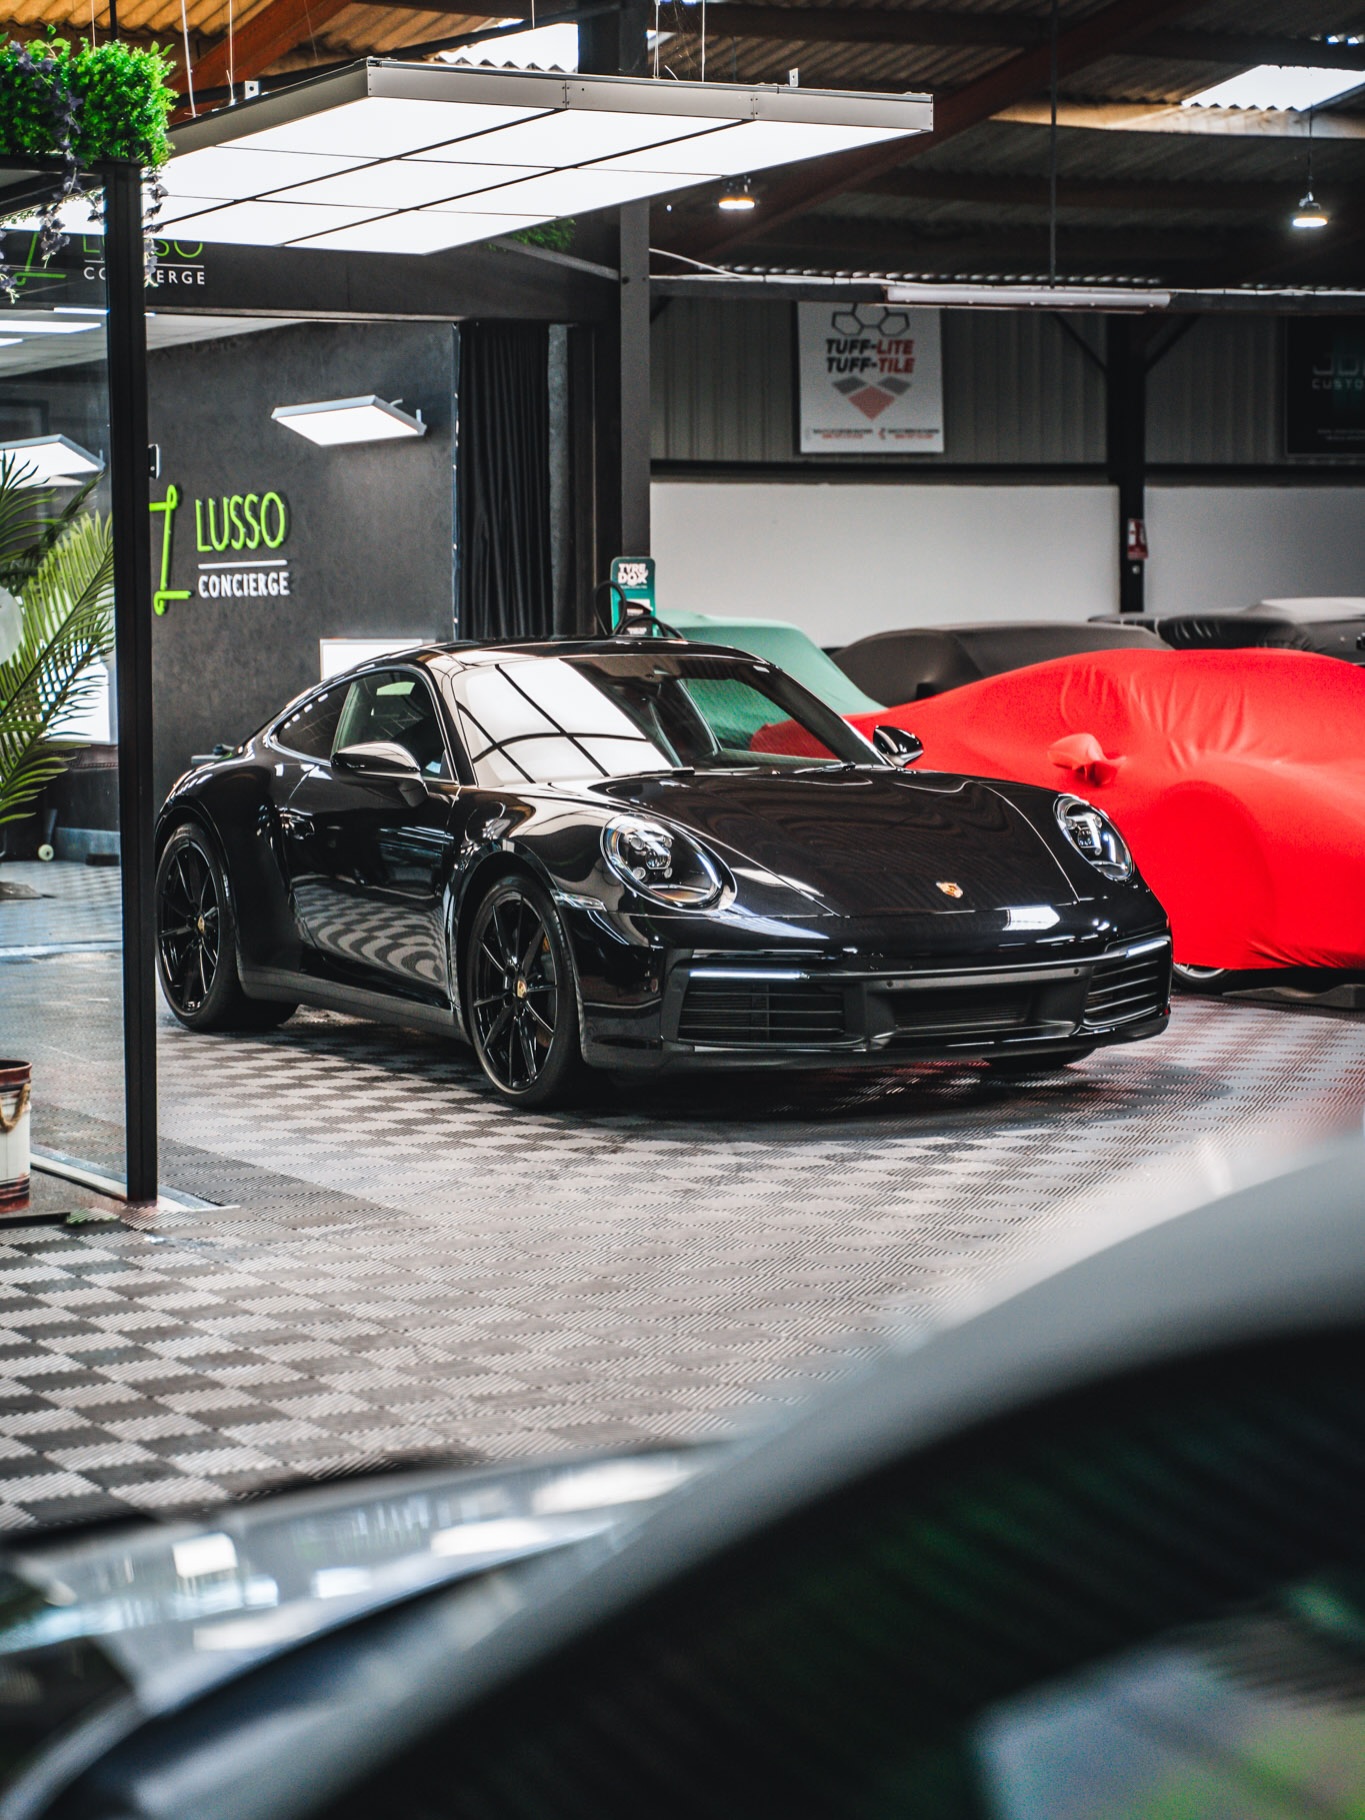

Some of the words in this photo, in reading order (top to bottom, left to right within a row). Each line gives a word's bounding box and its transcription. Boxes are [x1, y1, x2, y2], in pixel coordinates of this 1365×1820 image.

[83, 266, 206, 286] COERGE
[826, 339, 914, 355] TUFF-LITE
[827, 357, 914, 374] TUFF-TILE
[195, 491, 287, 552] LUSSO
[198, 571, 290, 599] CONCIERGE
